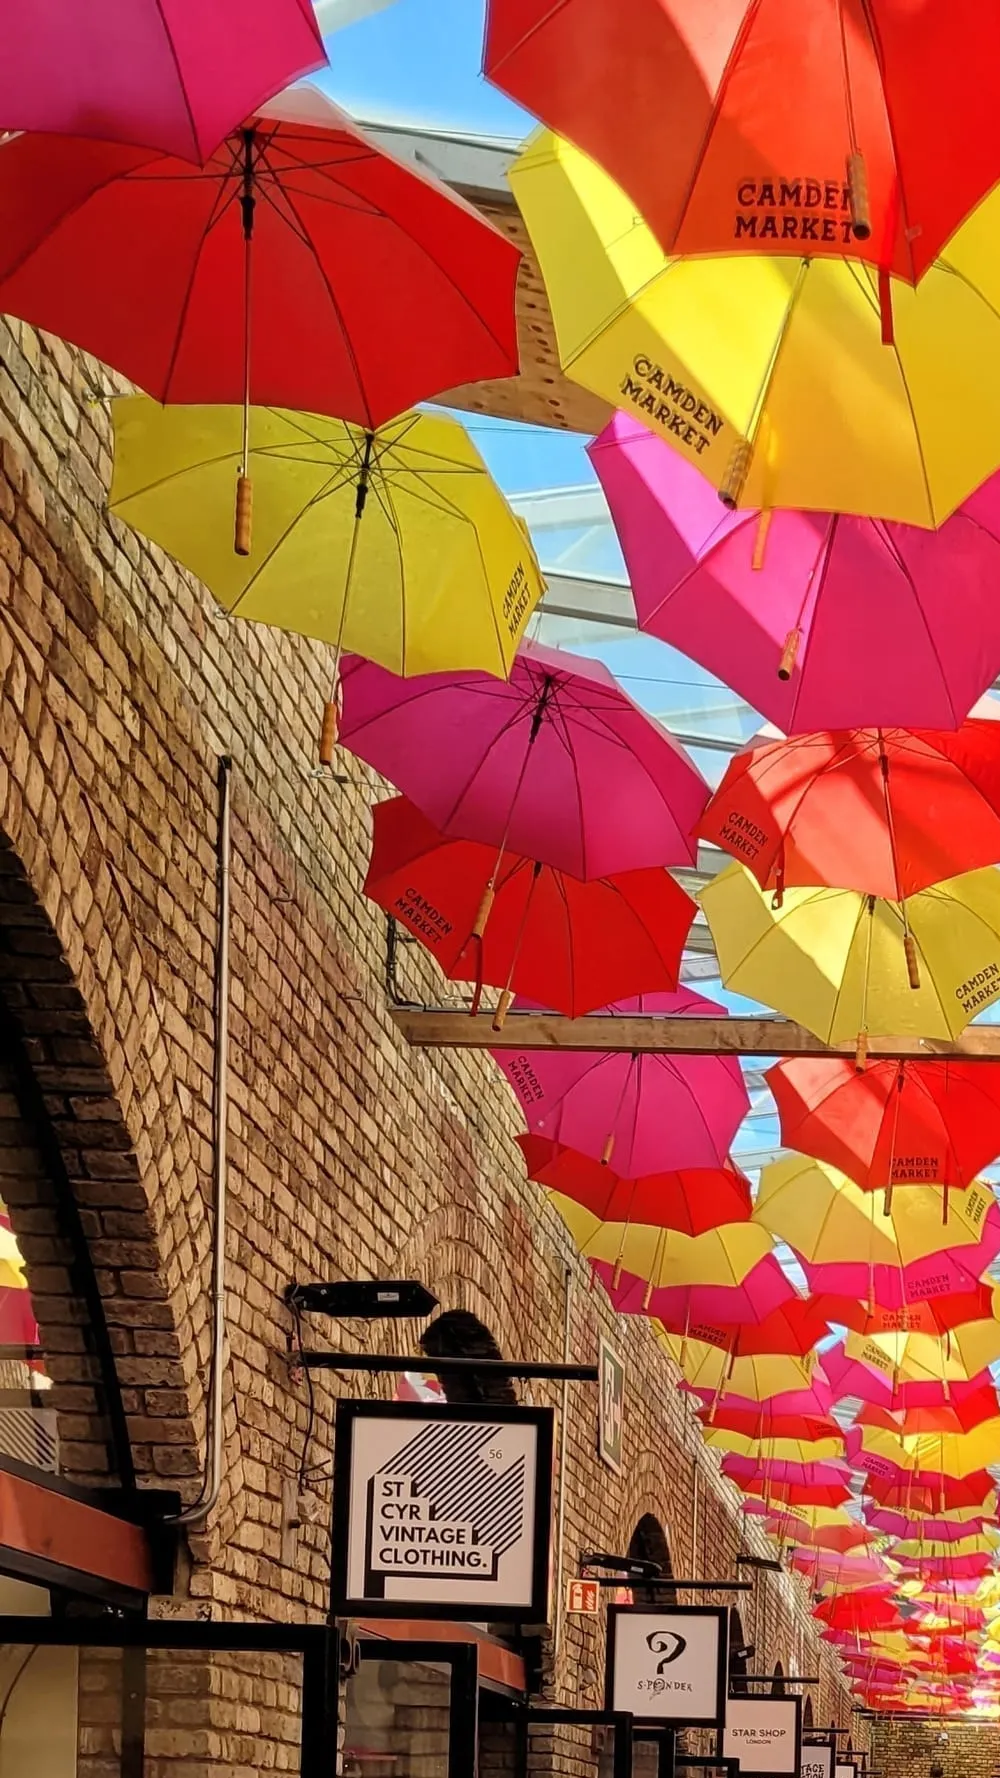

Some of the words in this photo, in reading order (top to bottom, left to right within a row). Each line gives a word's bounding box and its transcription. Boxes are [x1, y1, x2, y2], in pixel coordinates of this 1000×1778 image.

[734, 215, 854, 244] MARKET
[632, 356, 725, 437] CAMDEN
[620, 377, 711, 455] MARKET
[502, 561, 525, 620] CAMDEN
[508, 581, 532, 641] MARKET
[718, 825, 760, 861] MARKET
[727, 811, 769, 848] CAMDEN
[394, 897, 443, 945] MARKET
[405, 887, 453, 935] CAMDEN
[955, 963, 1000, 1000] CAMDEN
[507, 1060, 535, 1105] MARKET
[517, 1055, 545, 1100] CAMDEN
[882, 1314, 921, 1322] CAMEN
[882, 1322, 921, 1330] MAET
[488, 1449, 503, 1460] 56
[381, 1481, 404, 1497] ST
[380, 1503, 421, 1520] CYR
[379, 1525, 466, 1545] VINTAGE
[379, 1547, 487, 1567] CLOTHING.
[732, 1729, 756, 1737] STAR
[759, 1729, 787, 1738] SHOP
